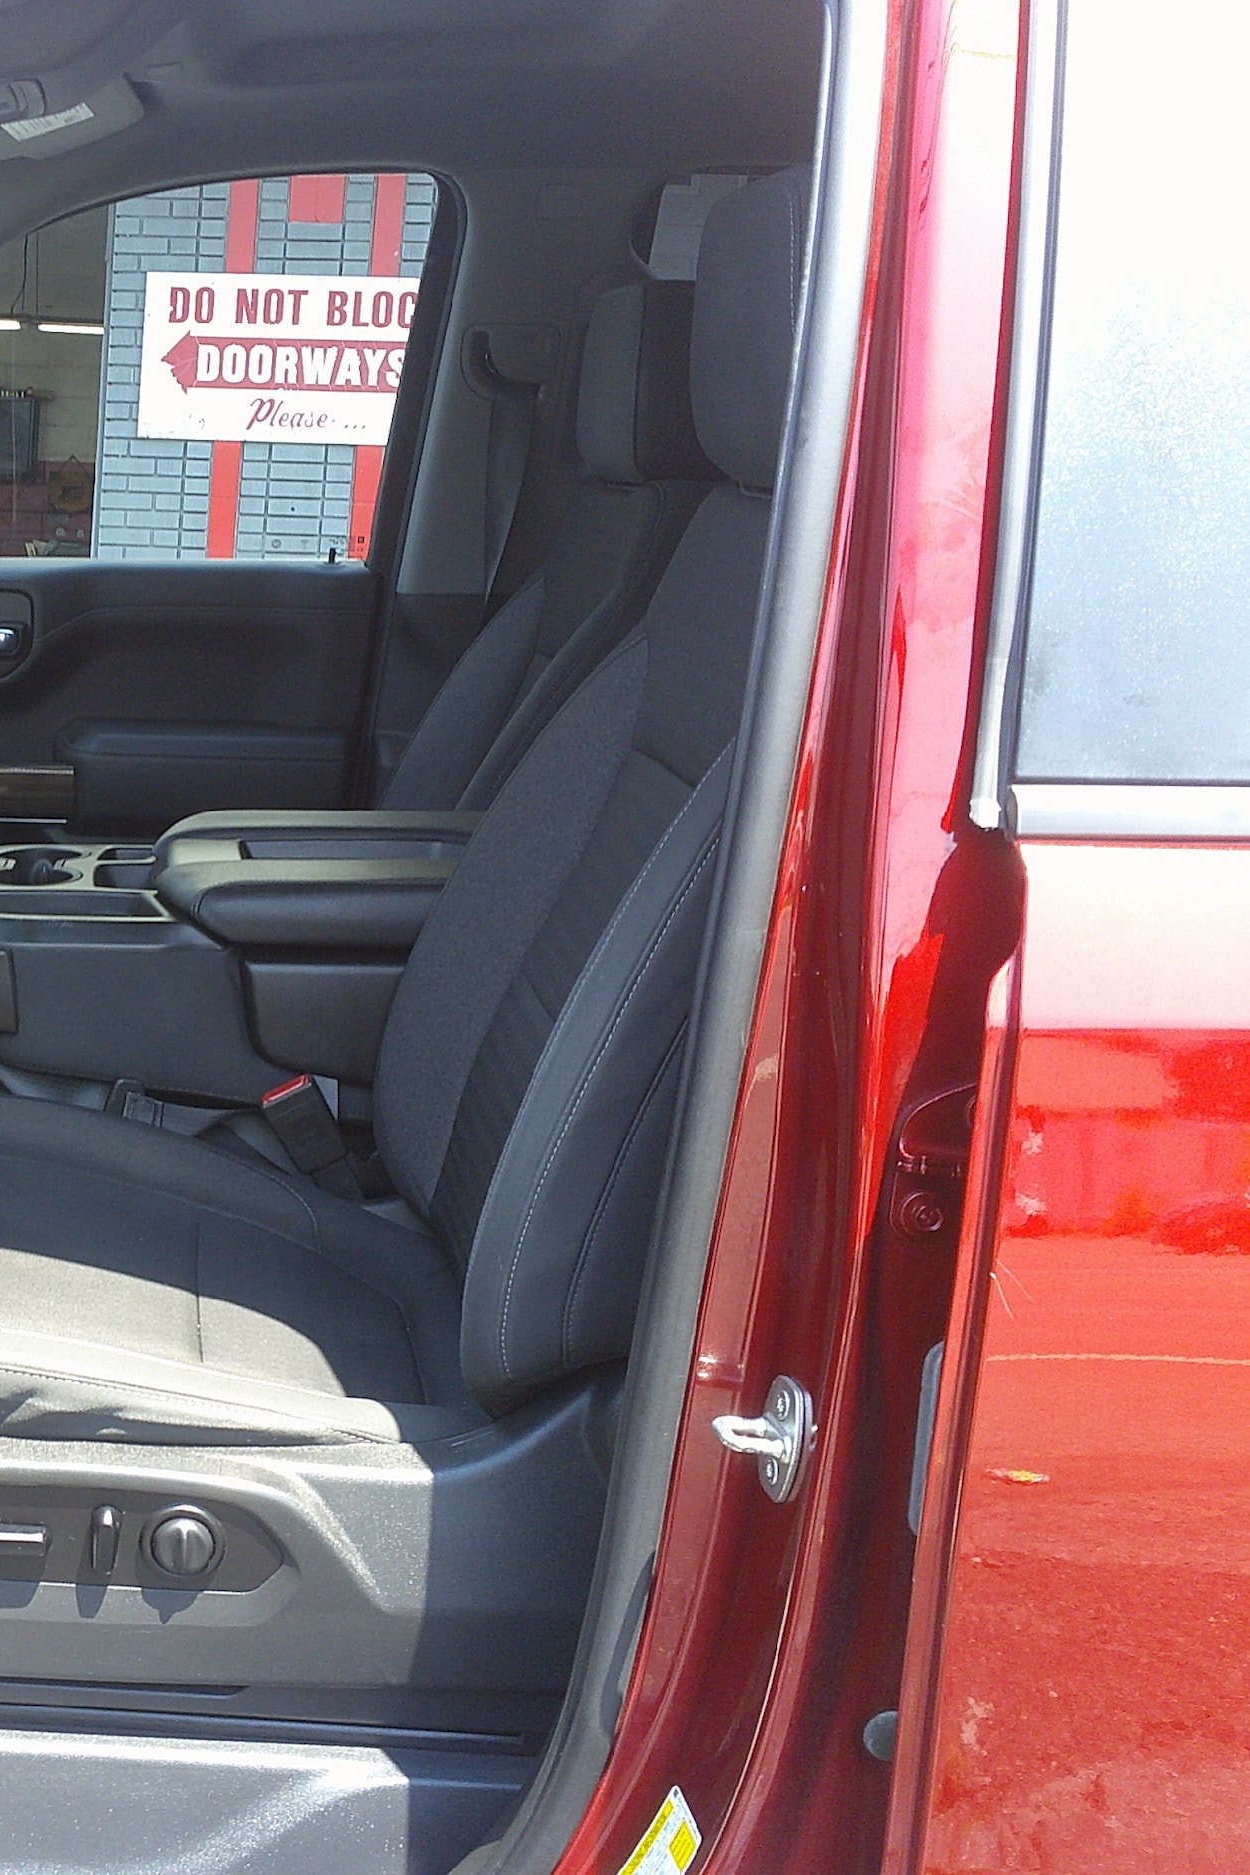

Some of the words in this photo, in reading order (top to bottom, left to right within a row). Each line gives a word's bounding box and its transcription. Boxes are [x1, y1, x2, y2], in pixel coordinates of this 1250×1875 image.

[168, 286, 216, 324] DO
[234, 288, 309, 326] NOT
[196, 342, 406, 388] DOORWAYS
